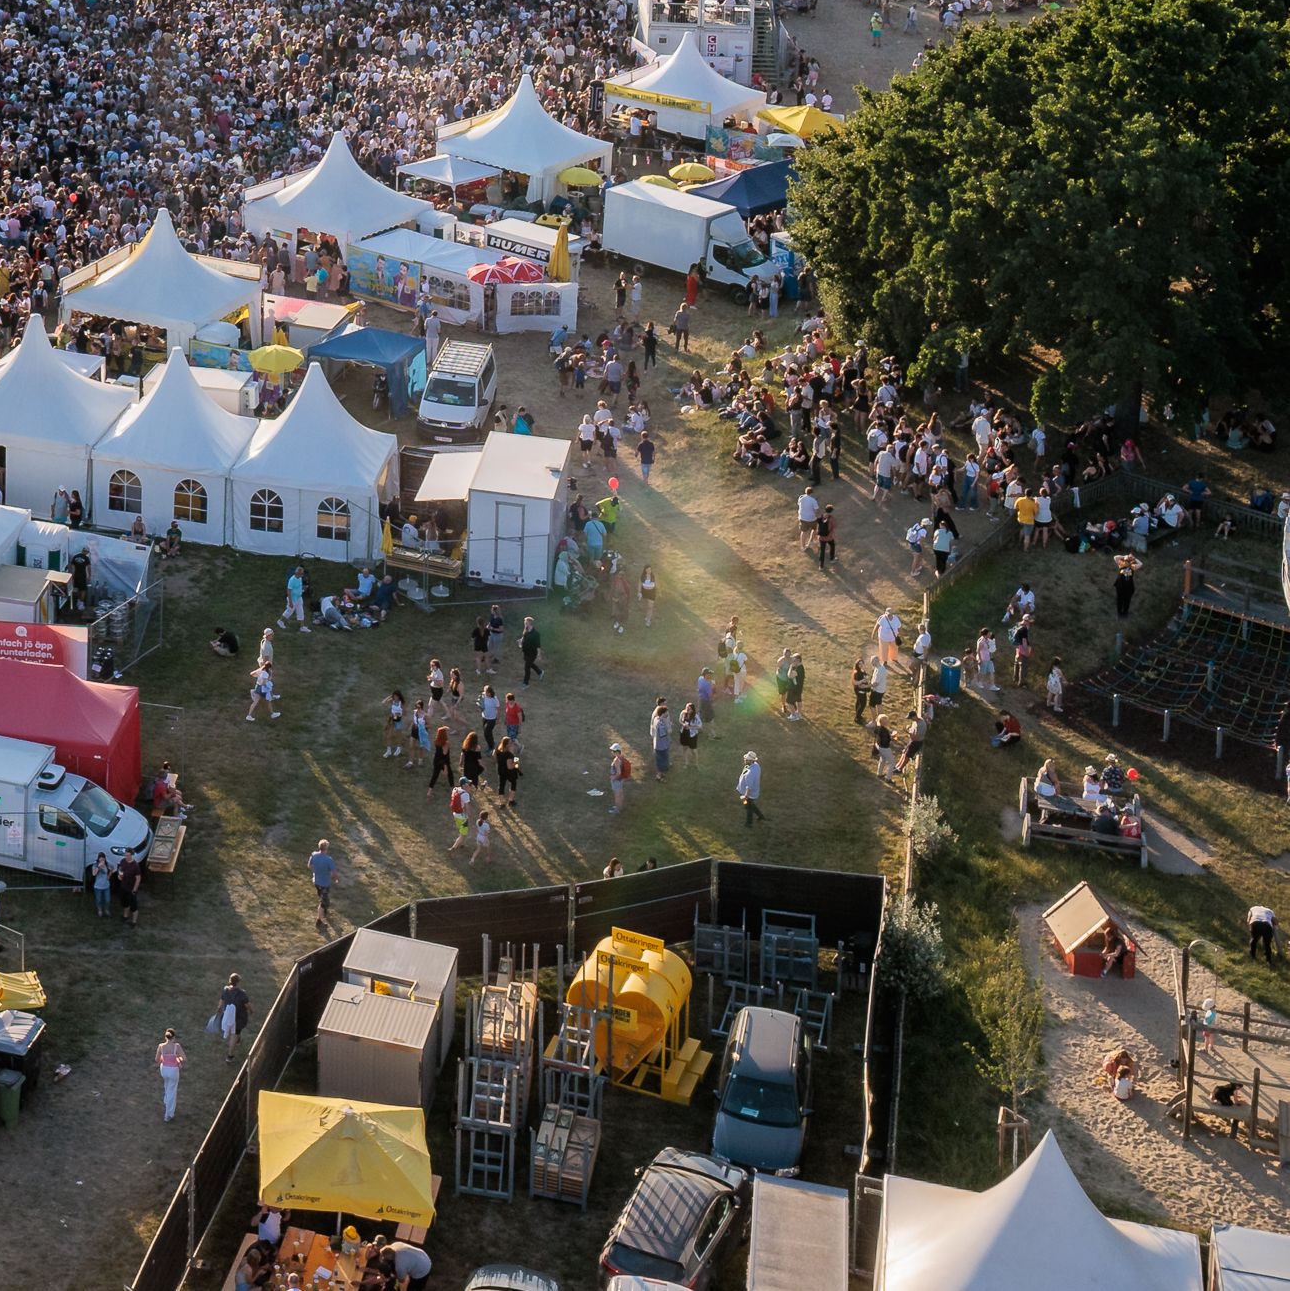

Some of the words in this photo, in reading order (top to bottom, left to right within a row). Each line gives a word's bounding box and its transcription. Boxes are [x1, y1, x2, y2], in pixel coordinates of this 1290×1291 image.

[489, 236, 550, 261] HUMER
[24, 640, 34, 650] jö
[35, 641, 54, 651] äpp
[615, 932, 659, 951] Ottakringer
[284, 1193, 322, 1204] Ottakringer
[385, 1205, 423, 1219] Ottakringer
